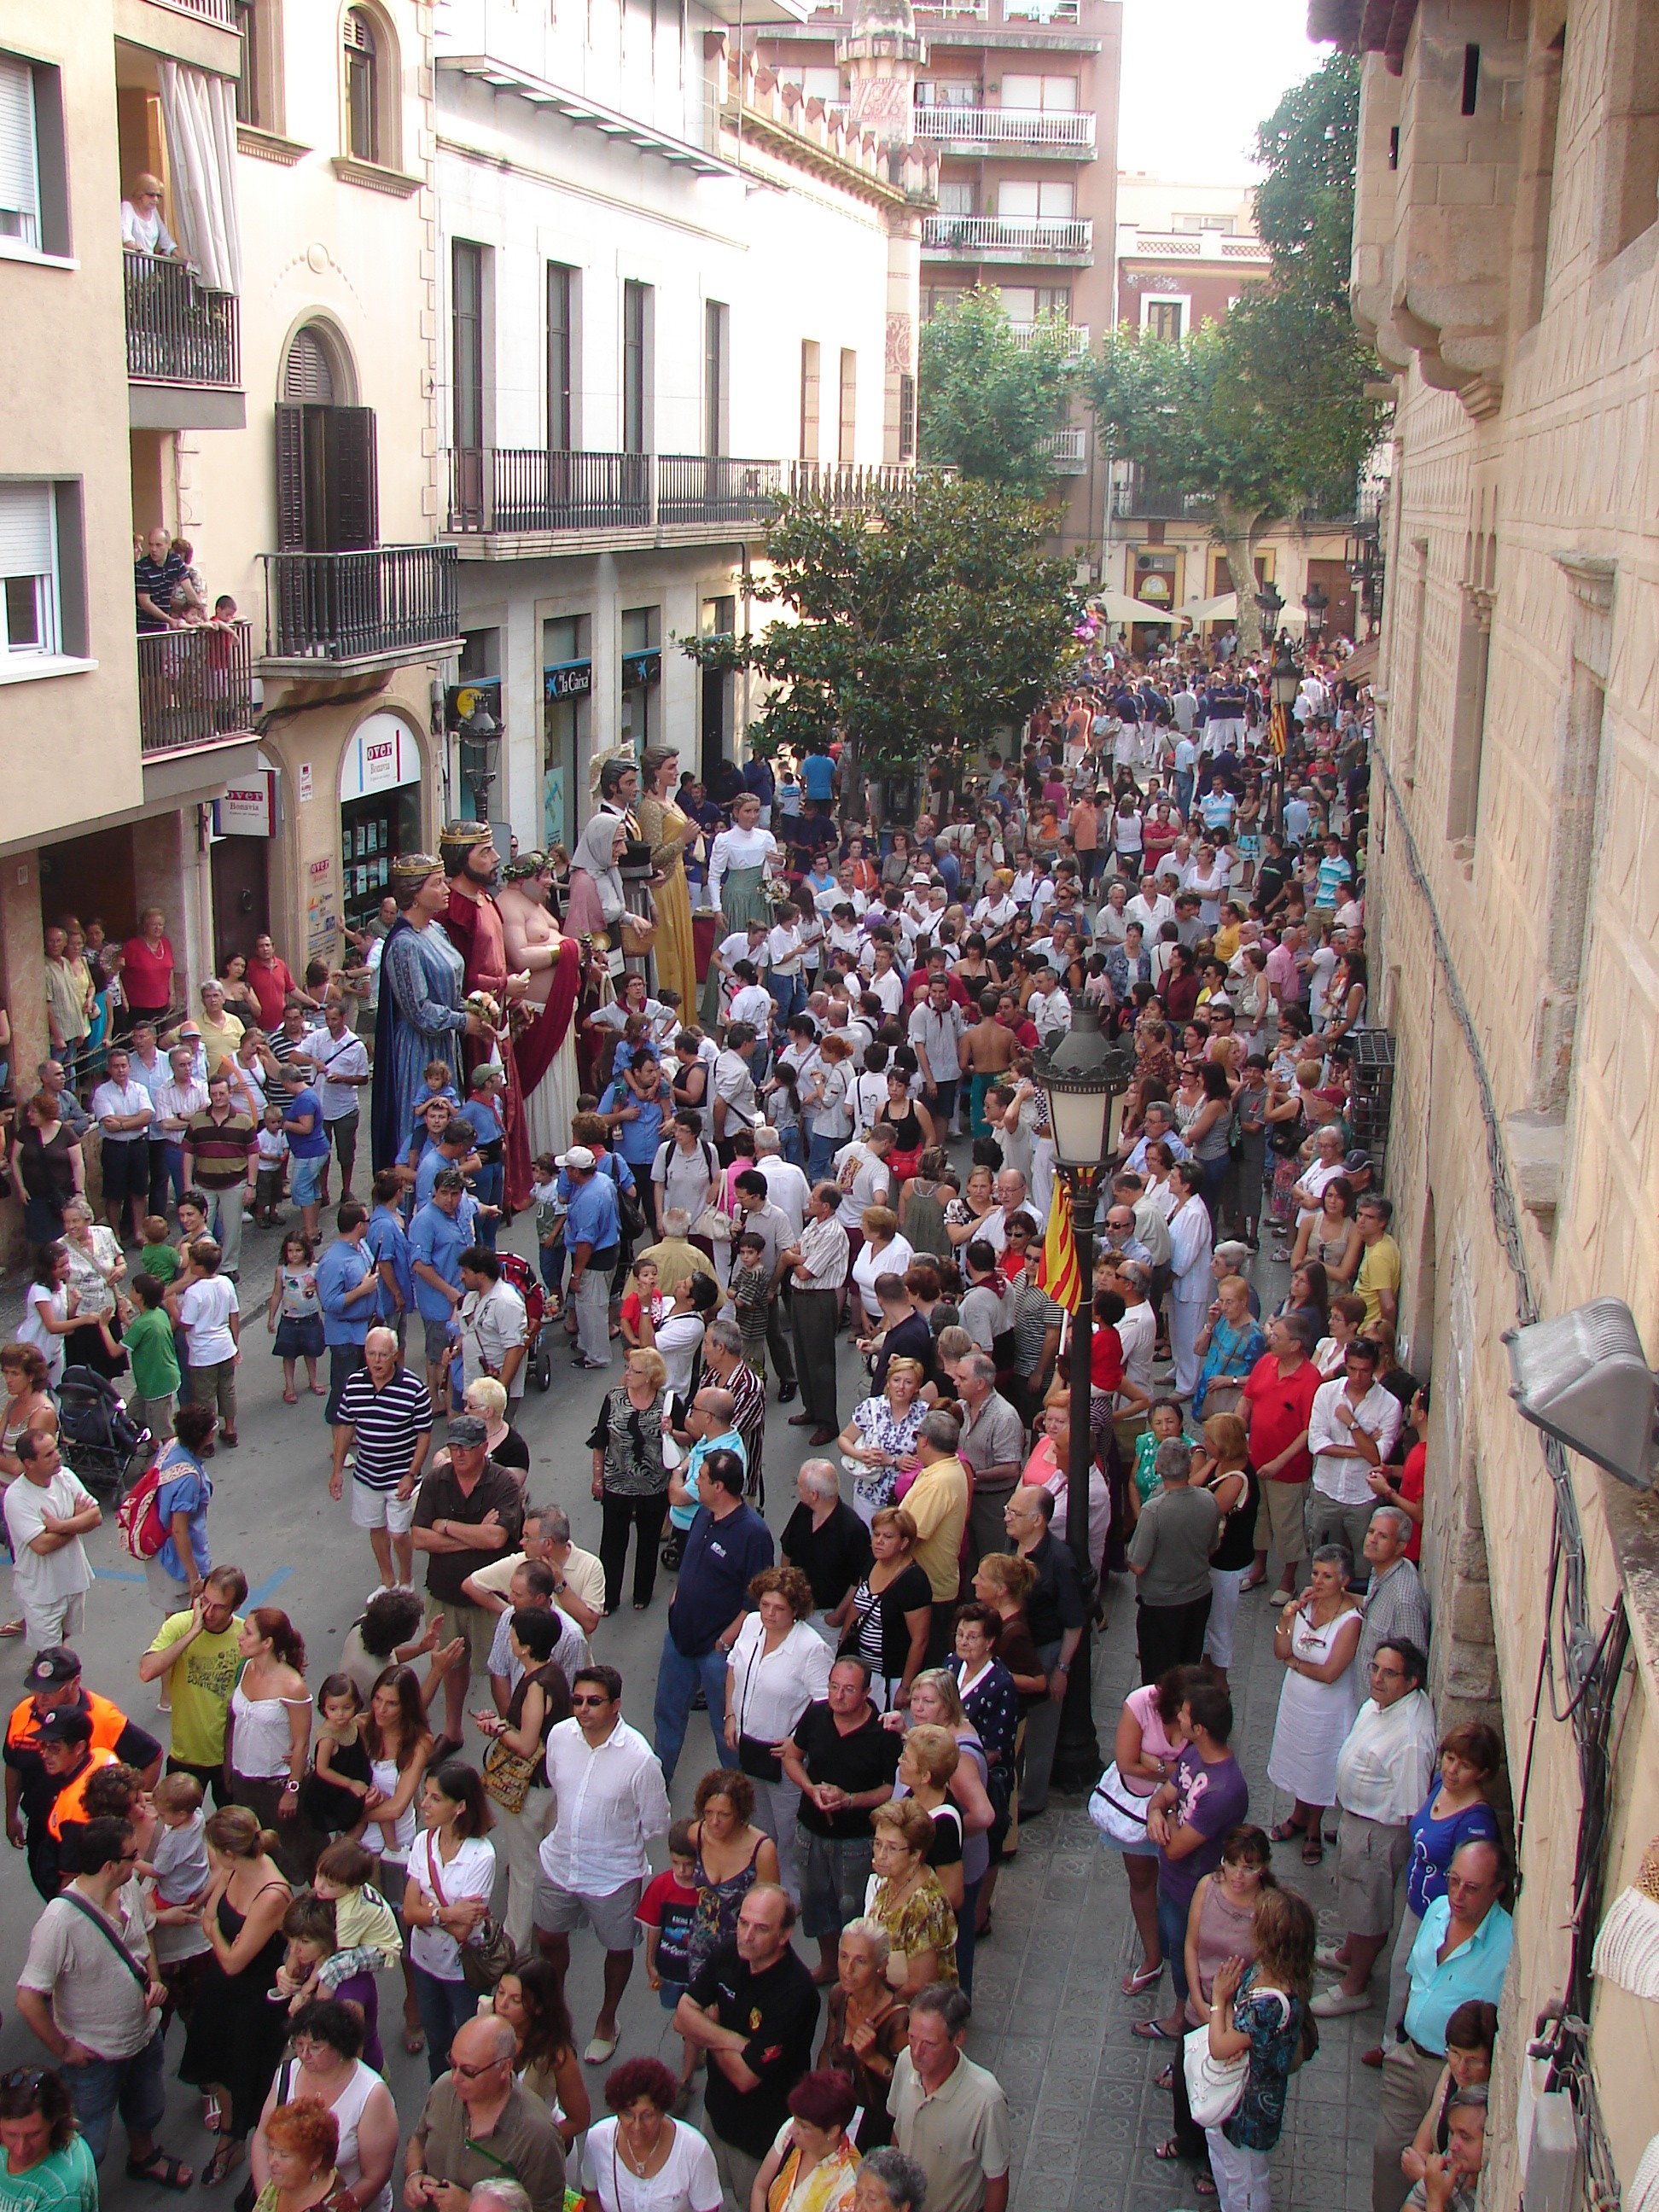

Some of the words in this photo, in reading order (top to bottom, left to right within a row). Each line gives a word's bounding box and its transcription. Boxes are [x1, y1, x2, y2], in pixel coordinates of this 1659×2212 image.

[367, 742, 392, 760] over
[227, 791, 262, 800] over
[230, 802, 259, 811] Bonavia
